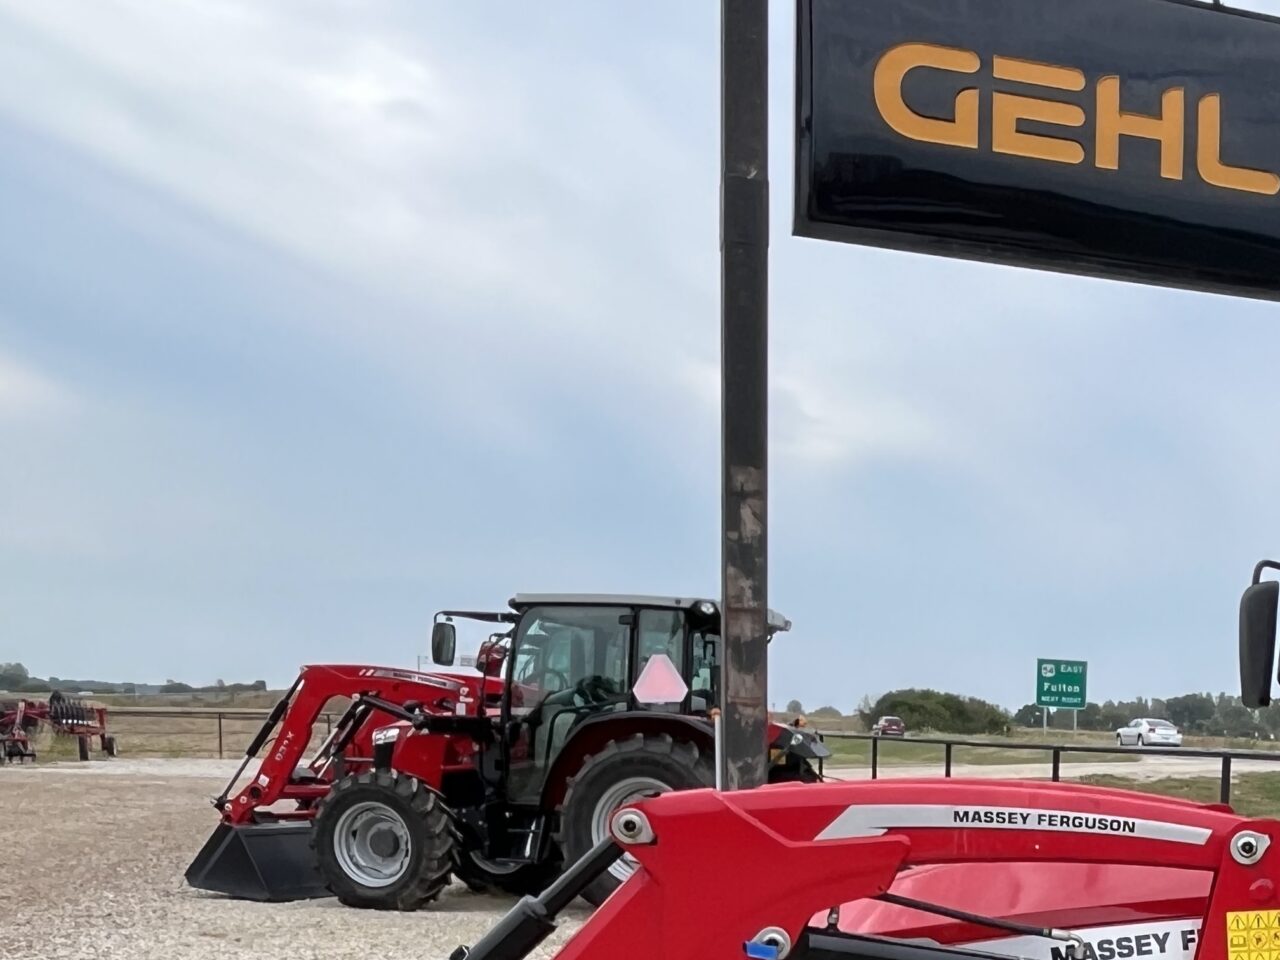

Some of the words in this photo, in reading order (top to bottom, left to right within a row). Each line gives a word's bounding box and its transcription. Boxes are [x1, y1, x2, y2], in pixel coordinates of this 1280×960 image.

[1060, 664, 1082, 673] EAST
[1043, 682, 1080, 692] Fulton
[953, 810, 1031, 825] MASSEY
[1037, 813, 1136, 833] FERGUSON
